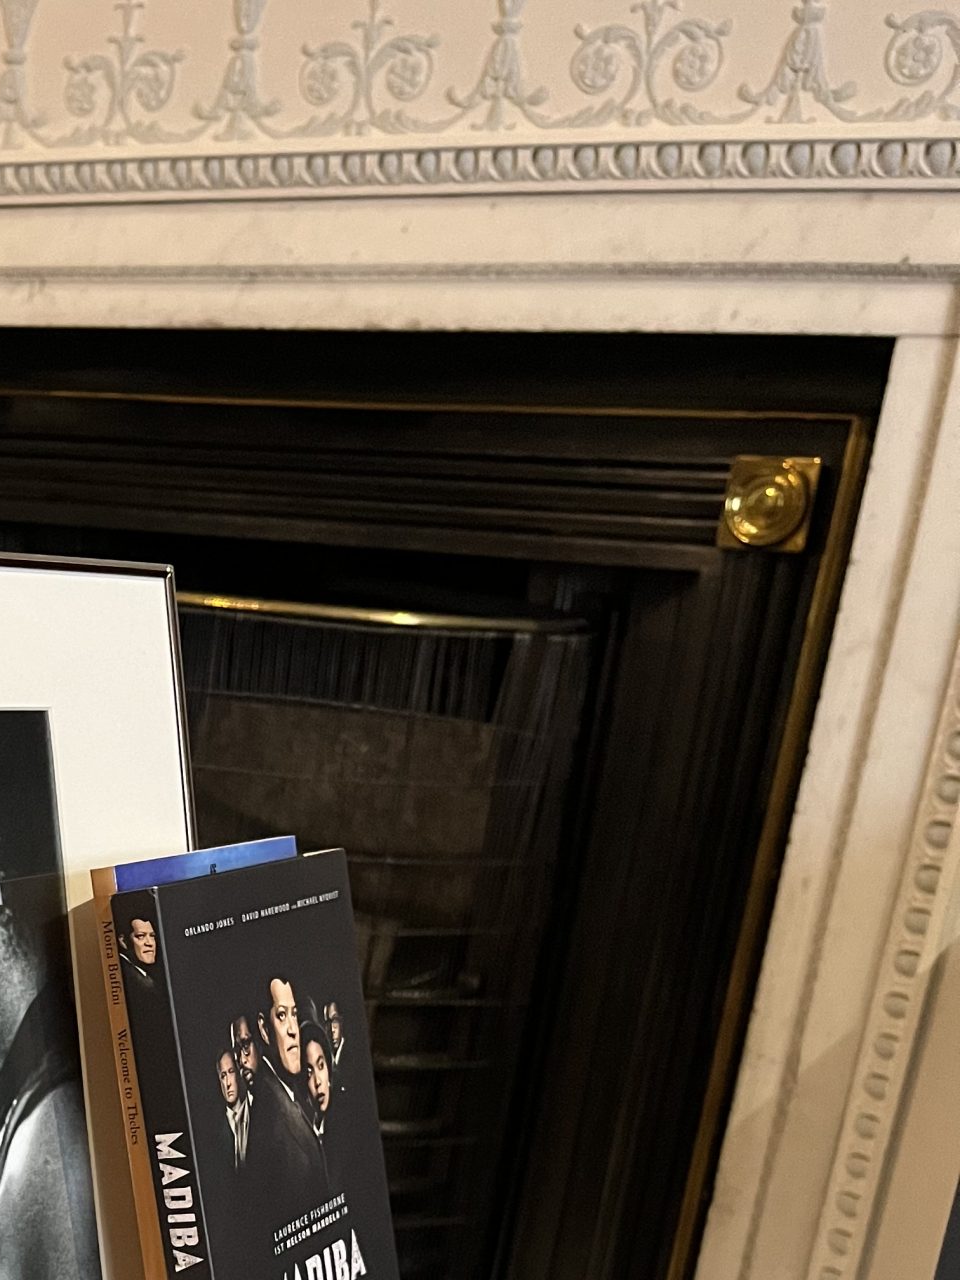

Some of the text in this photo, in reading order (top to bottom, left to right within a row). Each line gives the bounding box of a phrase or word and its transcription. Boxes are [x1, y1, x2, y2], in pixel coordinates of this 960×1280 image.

[185, 922, 214, 937] ORLANDO
[216, 917, 235, 929] JONES
[241, 910, 259, 923] DAVID
[260, 902, 290, 918] HAREWOOD
[101, 921, 121, 1006] Moira Buffini
[117, 1028, 140, 1145] Welcome to Thebes
[154, 1131, 205, 1273] MADIBA
[274, 1192, 345, 1242] LAURENCE FISHBURNE
[274, 1242, 284, 1255] IST
[286, 1227, 311, 1249] NELSON
[312, 1210, 340, 1233] MANDELA
